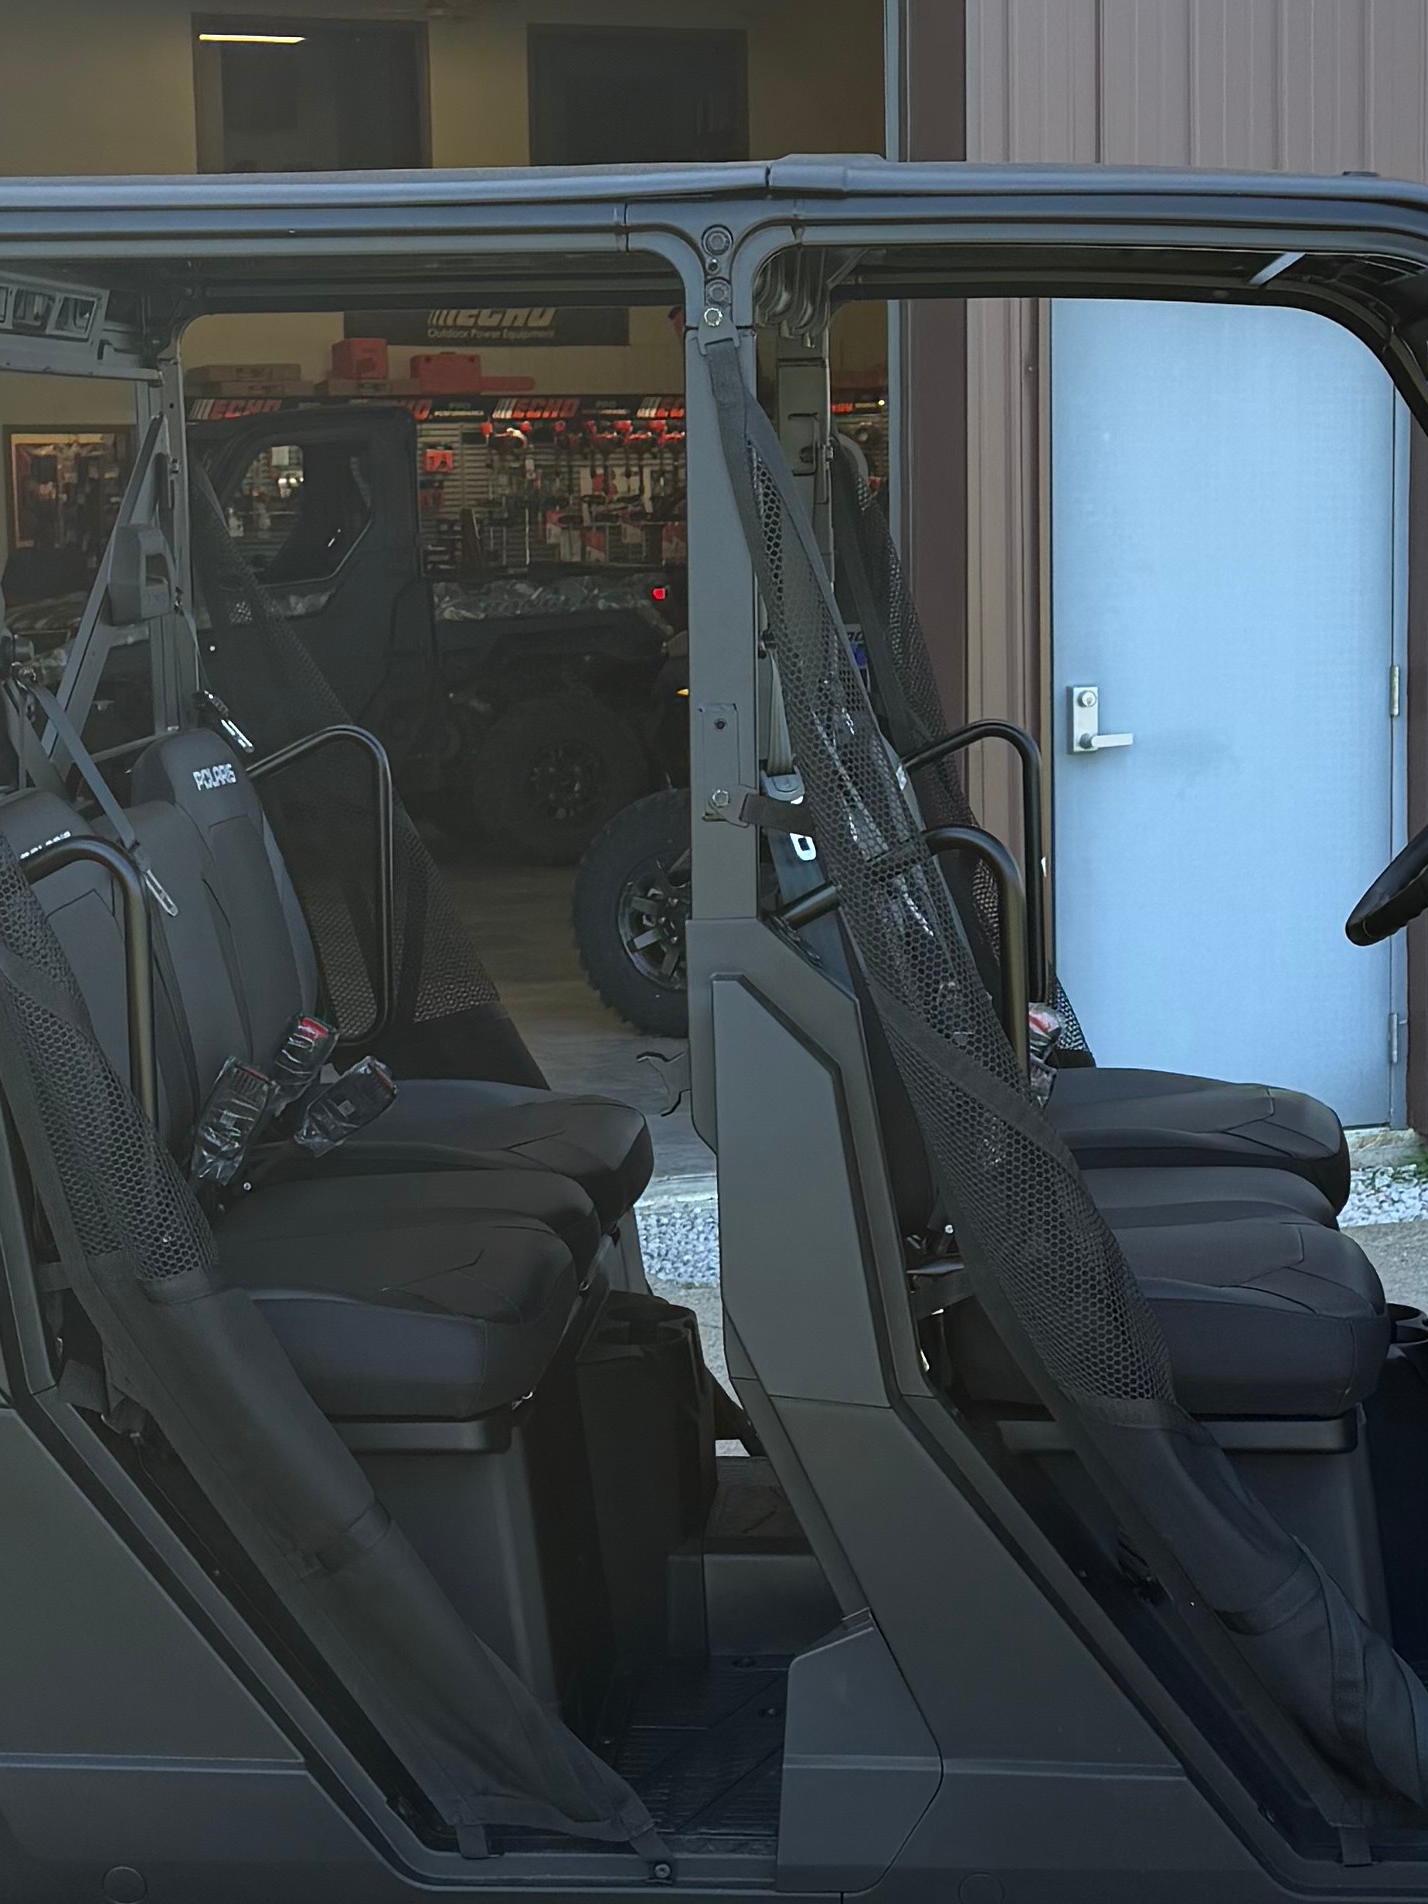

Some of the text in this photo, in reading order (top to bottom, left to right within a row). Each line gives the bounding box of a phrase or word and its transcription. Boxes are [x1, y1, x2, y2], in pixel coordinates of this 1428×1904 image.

[427, 327, 470, 339] Outdoor
[471, 328, 501, 339] Power
[512, 398, 580, 419] ECHO
[192, 763, 237, 791] POLARIS
